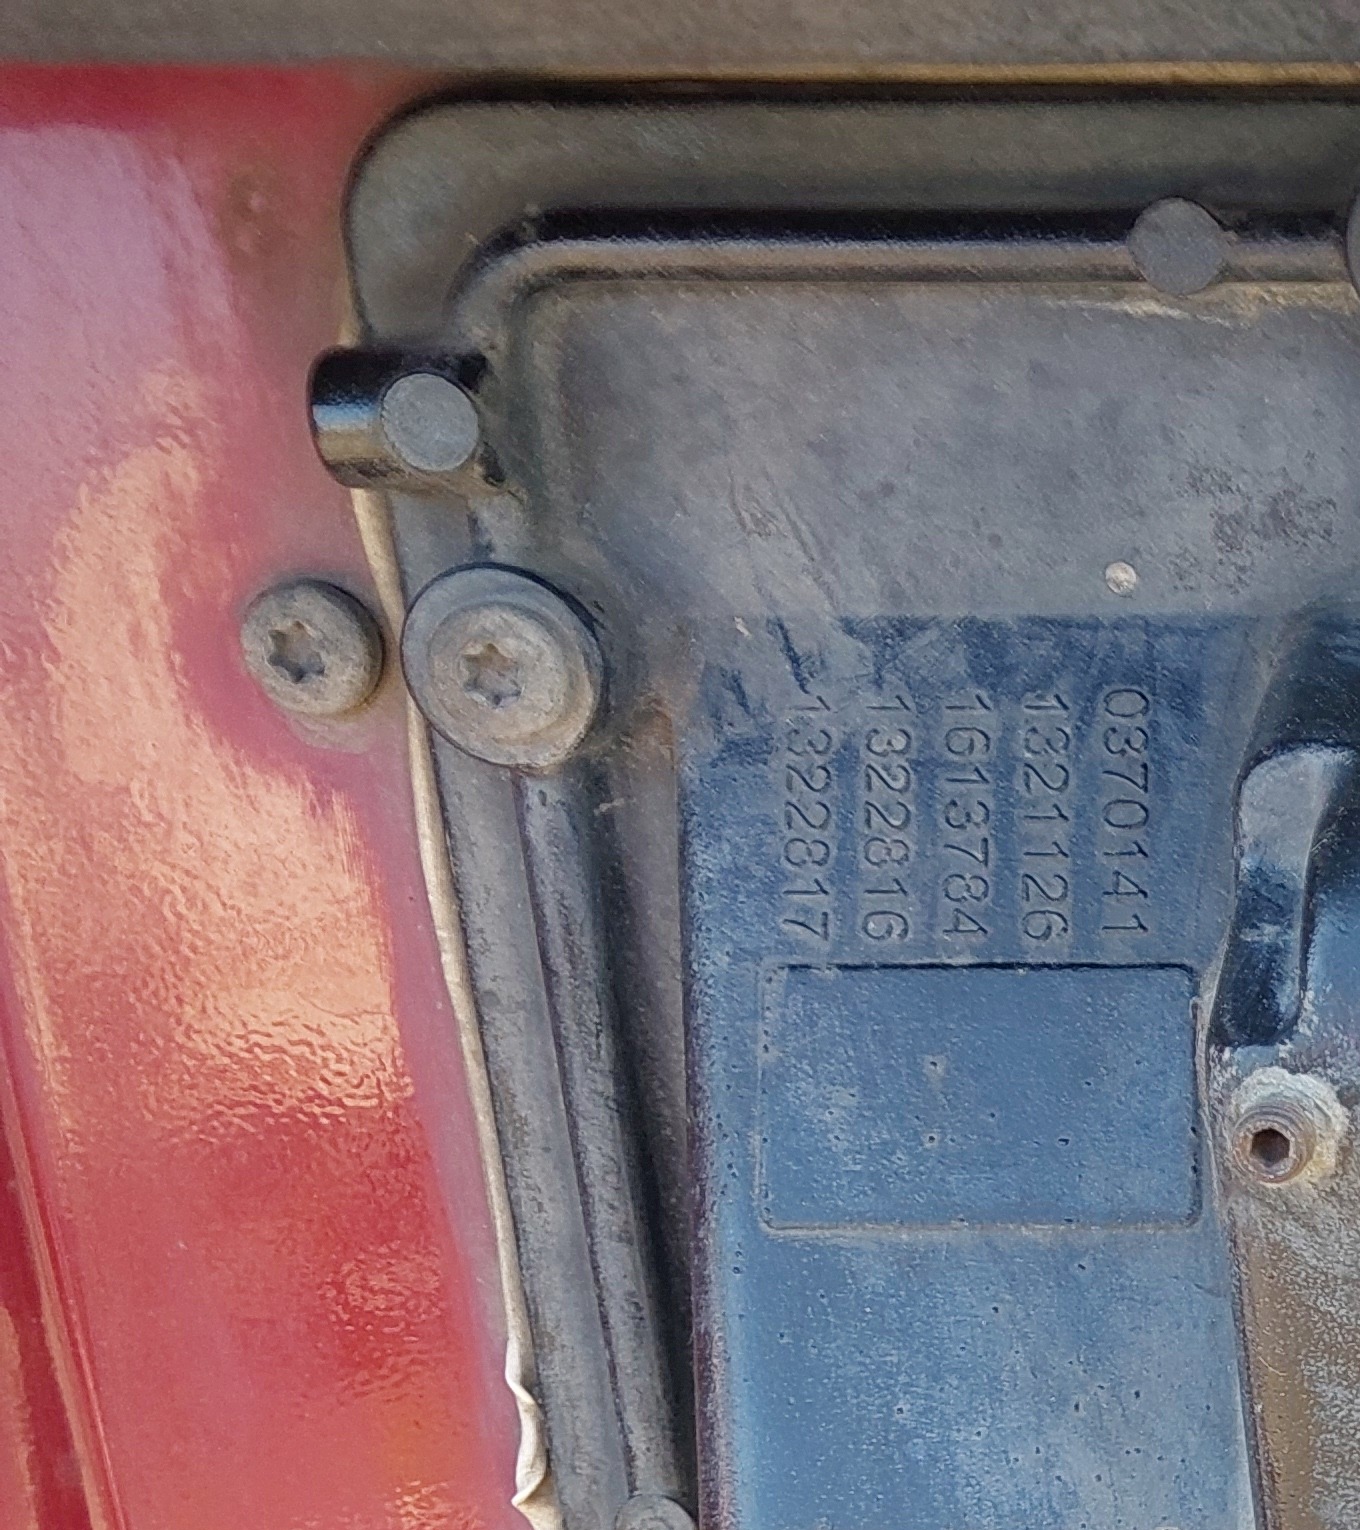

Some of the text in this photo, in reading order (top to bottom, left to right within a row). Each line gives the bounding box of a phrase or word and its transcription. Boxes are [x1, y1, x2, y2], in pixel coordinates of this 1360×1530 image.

[782, 692, 835, 943] 1322817
[861, 693, 914, 941] 1322816
[941, 692, 993, 940] 1613784
[1020, 692, 1072, 943] 1321126
[1102, 687, 1150, 937] 0370141
